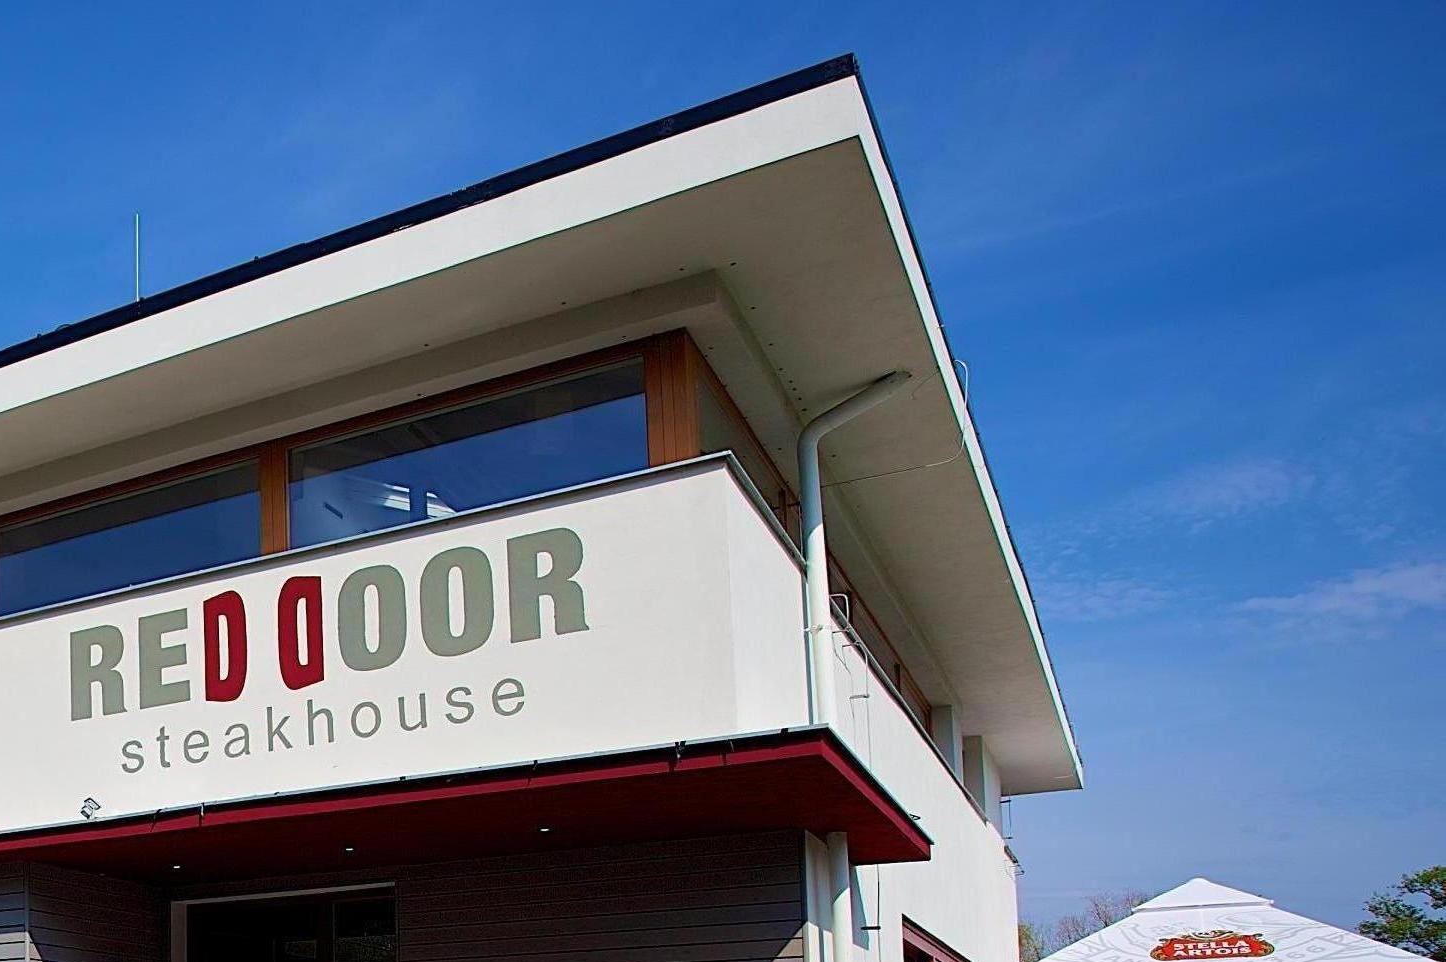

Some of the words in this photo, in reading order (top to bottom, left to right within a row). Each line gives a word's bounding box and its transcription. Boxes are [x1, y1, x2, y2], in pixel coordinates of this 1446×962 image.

[69, 590, 248, 722] RED
[277, 527, 590, 690] DOOR
[120, 676, 526, 774] steakhouse
[1173, 940, 1250, 951] STELLA
[1173, 947, 1252, 957] ARTOIS
